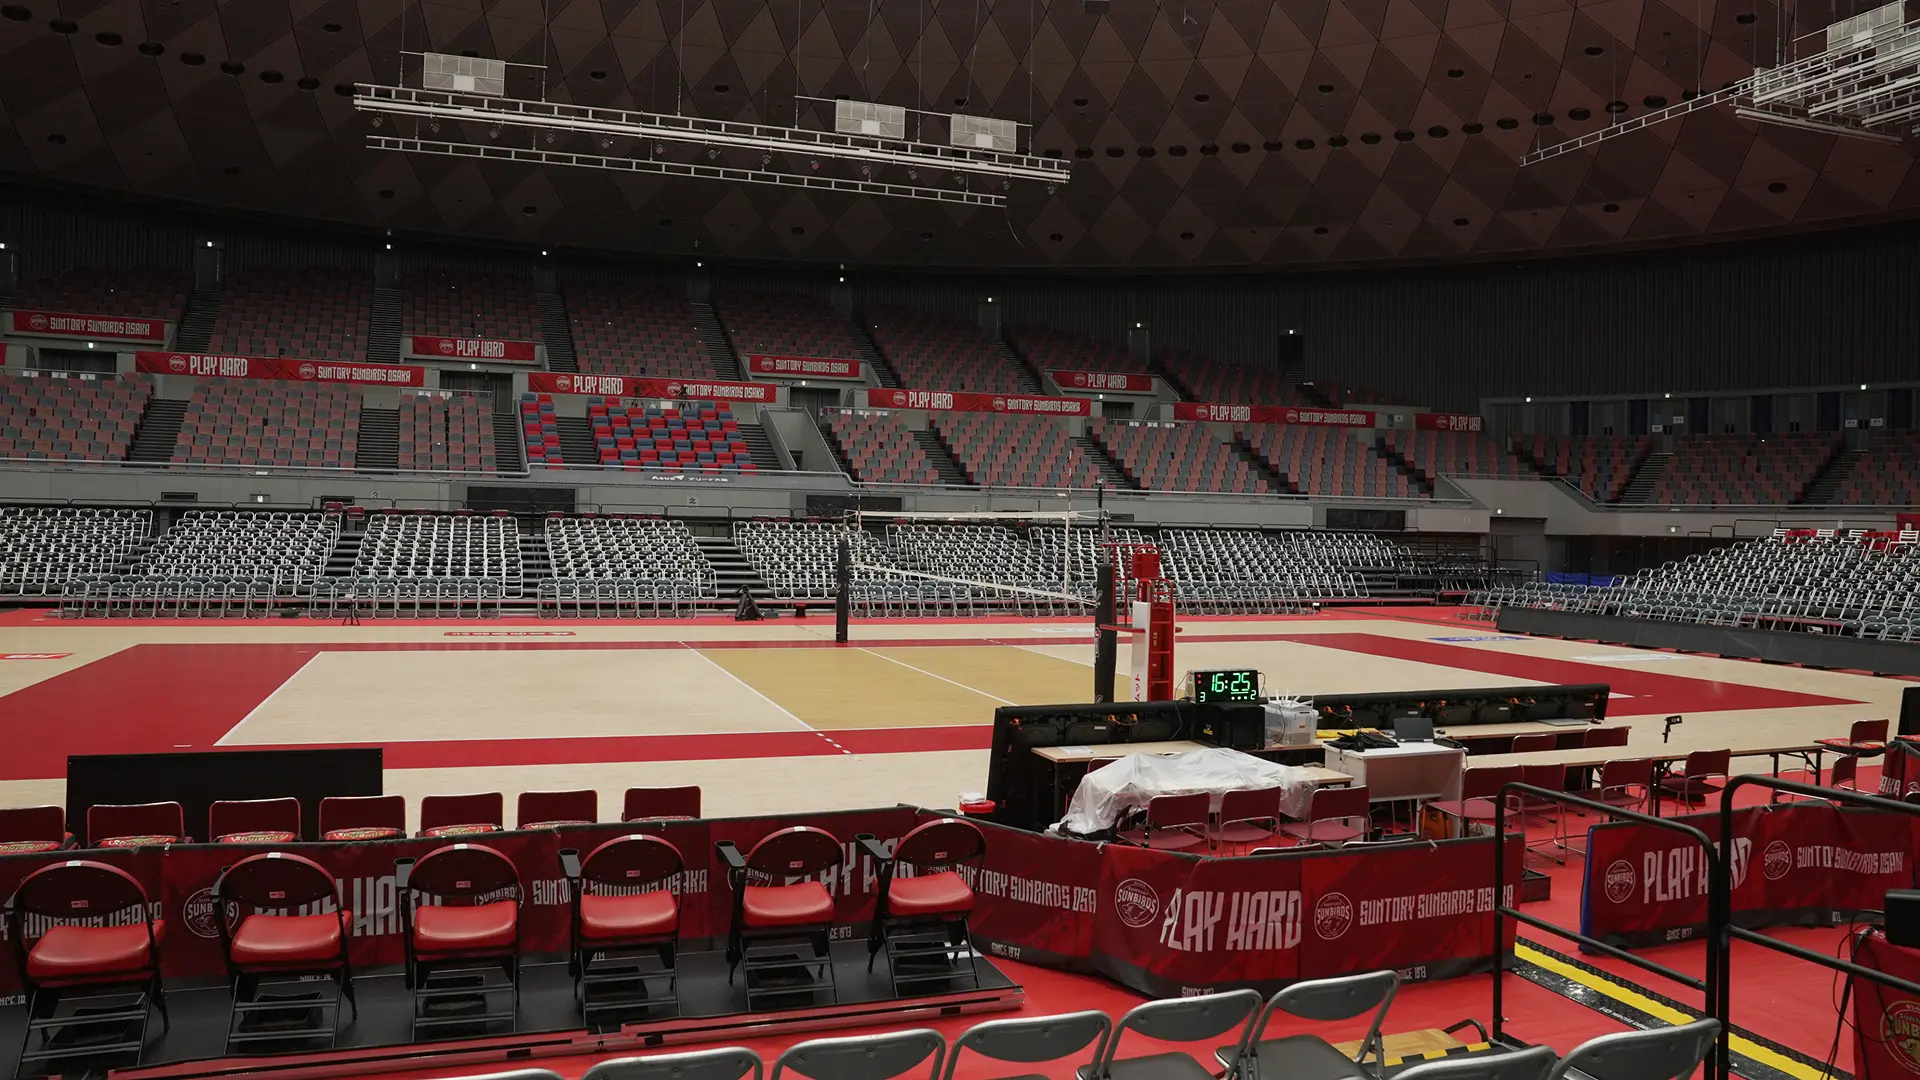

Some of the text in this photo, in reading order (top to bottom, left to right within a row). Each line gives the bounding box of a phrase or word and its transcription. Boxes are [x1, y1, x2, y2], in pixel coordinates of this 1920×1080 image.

[50, 317, 150, 336] SUNTORY SUNBIRDS OSAKA
[456, 339, 505, 358] PLAY HARD
[189, 355, 248, 377] PLAY HARD
[317, 365, 411, 383] SUNTORY SUNBIRDS OSAKA
[775, 359, 849, 374] SUNTORY SUNBIRDS OSAKA
[573, 376, 623, 395] PLAY HARD
[1087, 373, 1127, 390] PLAY HARD
[712, 385, 744, 398] SUNBIRDS
[744, 386, 765, 399] OSAKA
[908, 391, 954, 410] PLAY HARD
[1007, 398, 1081, 413] SUNTORY SUNBIRDS OSAKA
[1210, 405, 1251, 422] PLAY HARD
[1449, 415, 1468, 431] PLAY
[1211, 672, 1251, 693] 16:25
[1199, 691, 1206, 703] 3
[1250, 689, 1257, 700] 2
[1643, 845, 1694, 904] PLAY
[1010, 875, 1070, 909] SUNBIRDS
[1117, 888, 1157, 914] SUNBIRDS
[1317, 905, 1350, 925] SUNBIRDS
[1359, 895, 1416, 926] SUNTORY
[1417, 889, 1475, 919] SUNBIRDS
[1159, 887, 1302, 953] PLAY HARD
